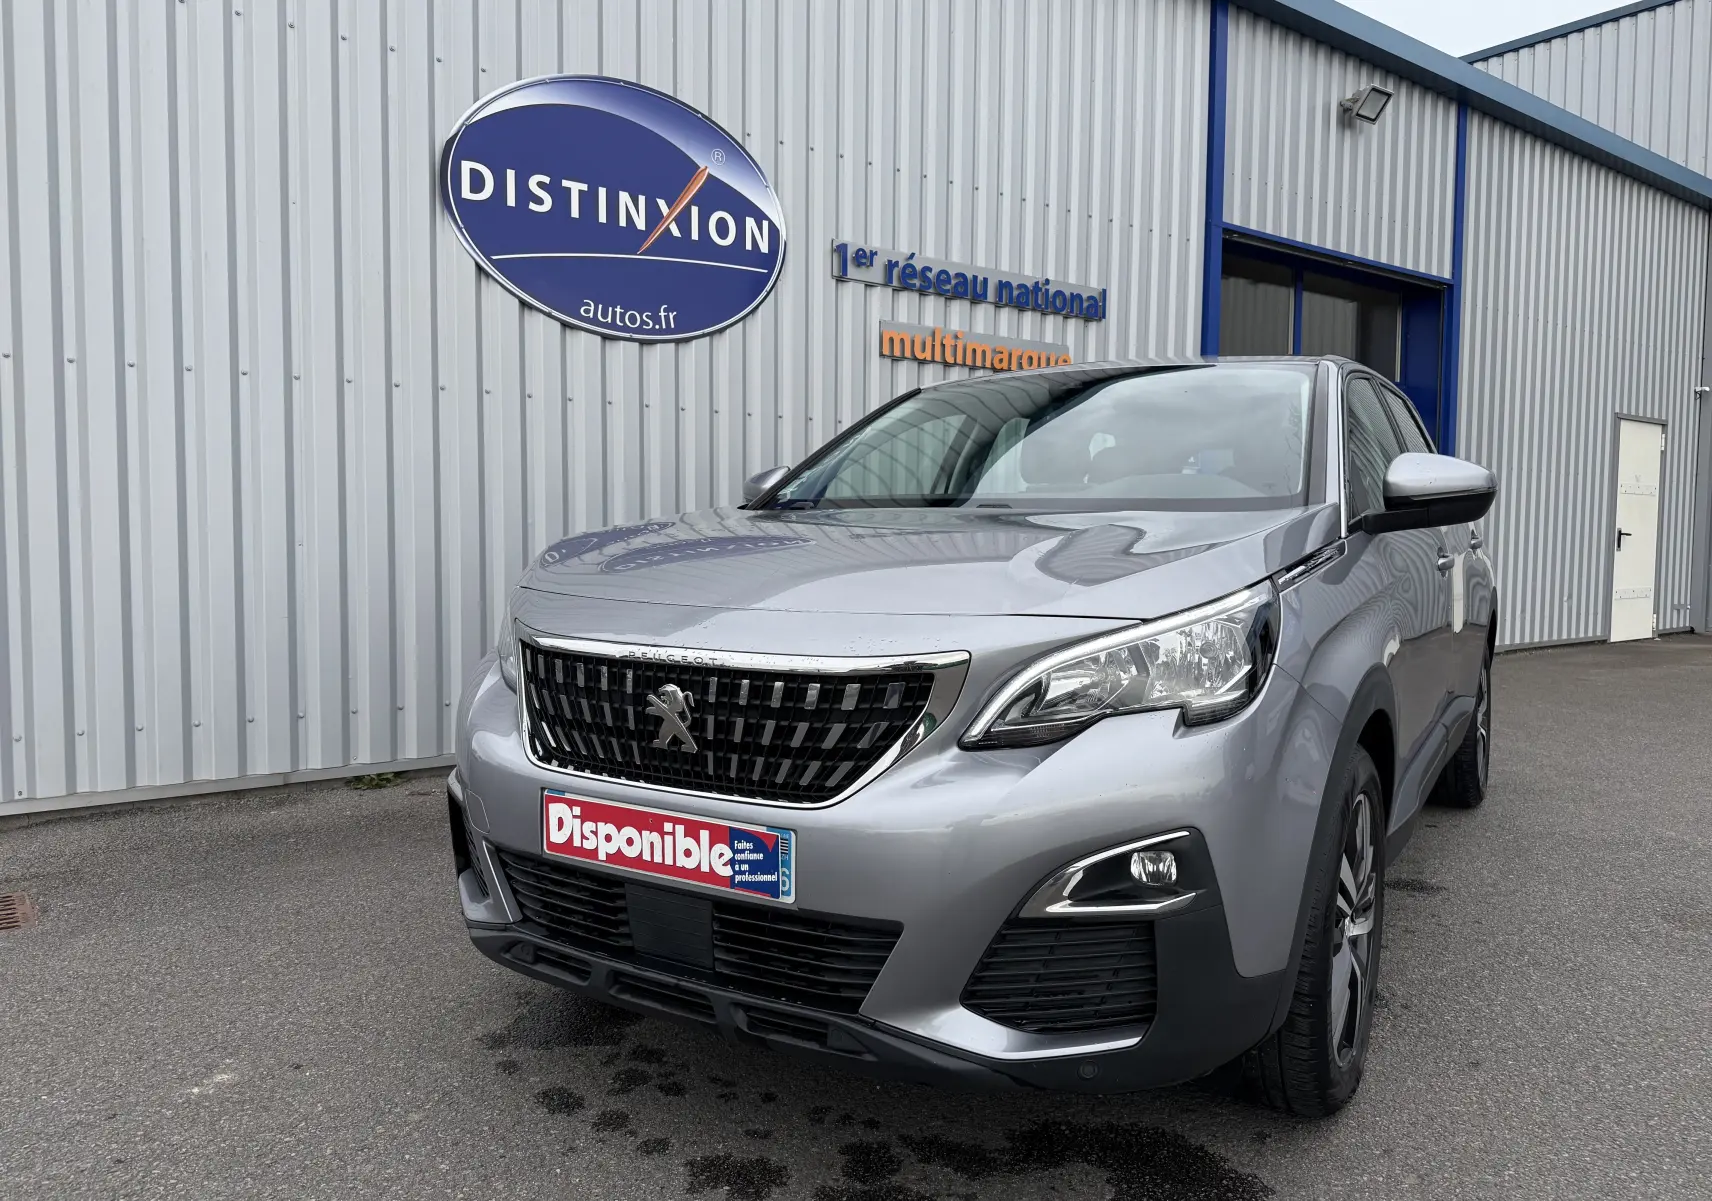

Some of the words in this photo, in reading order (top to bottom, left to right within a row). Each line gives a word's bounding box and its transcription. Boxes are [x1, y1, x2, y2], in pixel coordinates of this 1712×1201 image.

[460, 160, 769, 254] DISTINXION
[834, 243, 878, 277] 1er
[886, 252, 989, 301] réseau
[997, 278, 1107, 320] national
[580, 299, 677, 329] autos.fr
[628, 651, 718, 666] PEUGEOT
[548, 802, 734, 877] Disponible
[735, 840, 754, 850] Faites
[734, 851, 764, 861] confiance
[735, 861, 740, 871] à
[740, 863, 749, 871] un
[735, 872, 777, 883] professionnel
